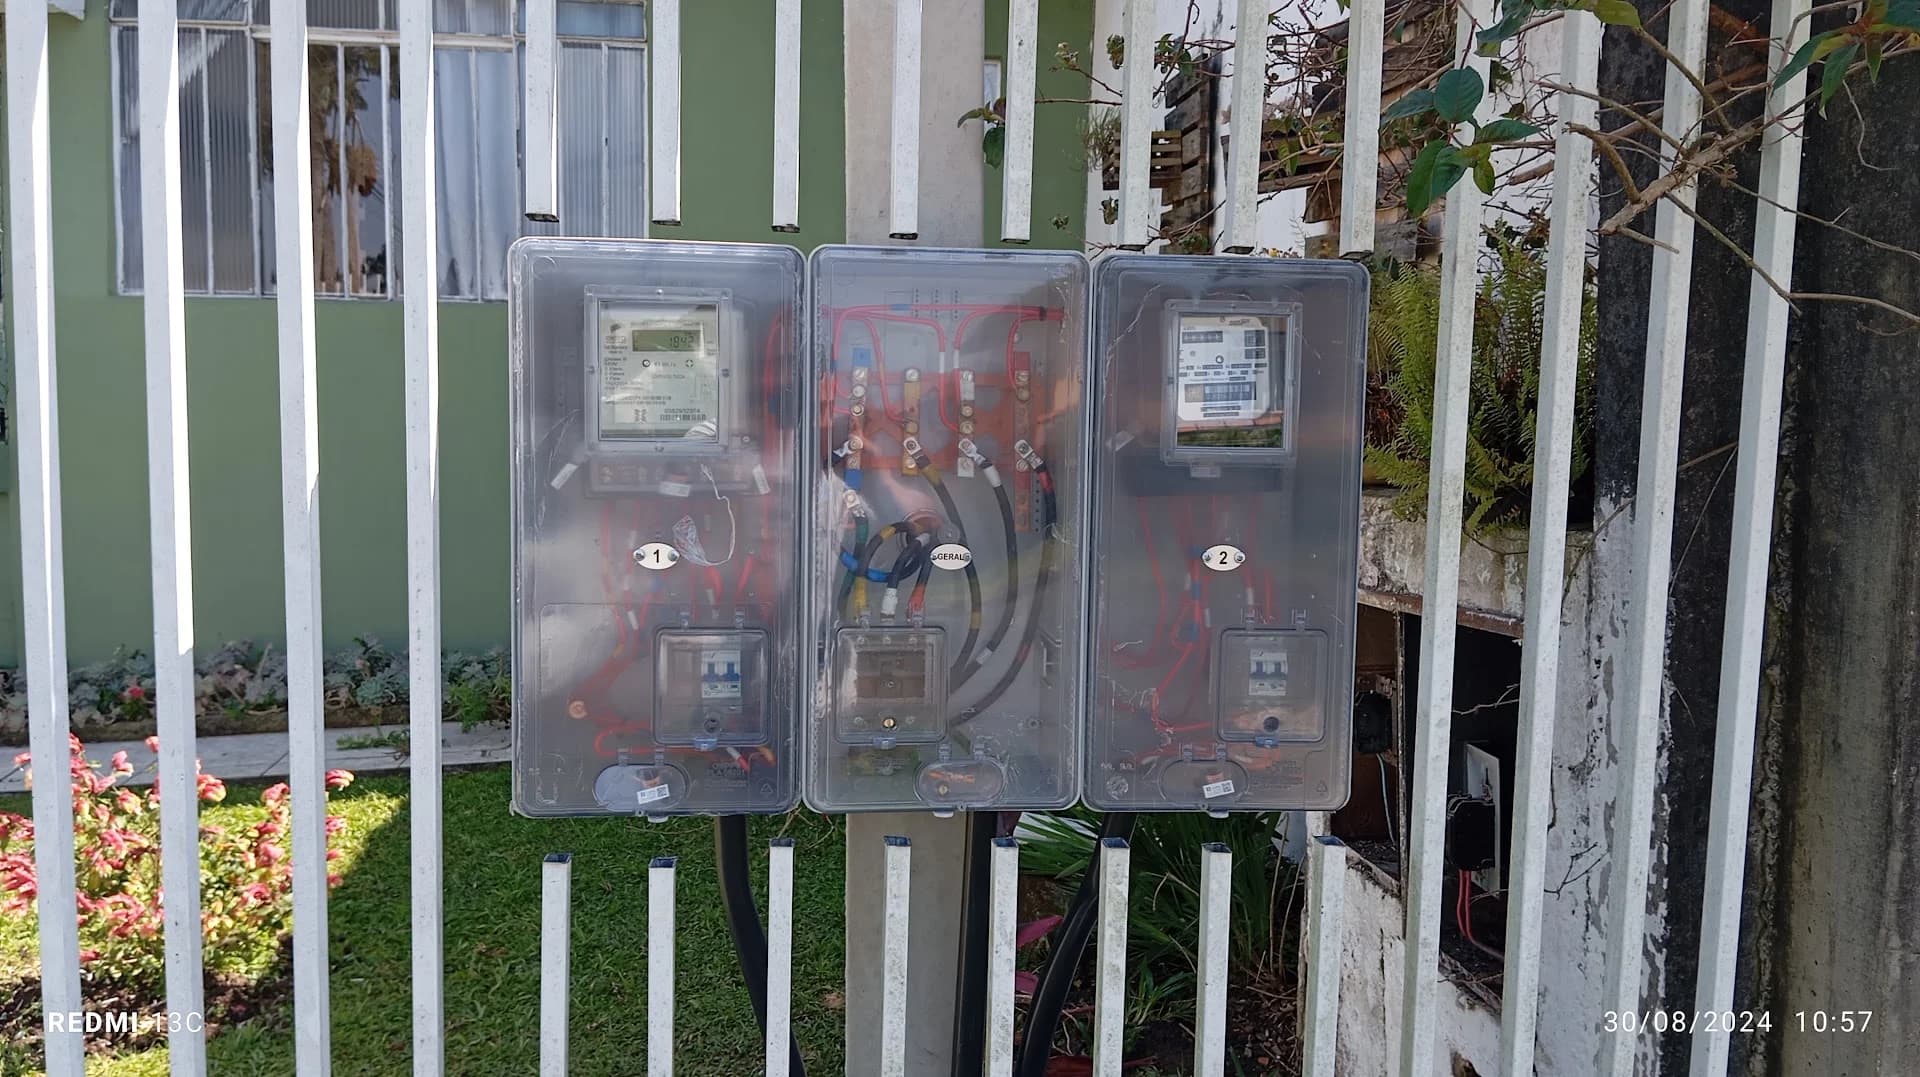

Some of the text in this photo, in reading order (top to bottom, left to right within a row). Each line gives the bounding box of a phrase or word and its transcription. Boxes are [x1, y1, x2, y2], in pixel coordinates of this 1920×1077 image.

[652, 549, 660, 563] 1
[937, 552, 964, 561] GERAL
[1219, 551, 1228, 565] 2
